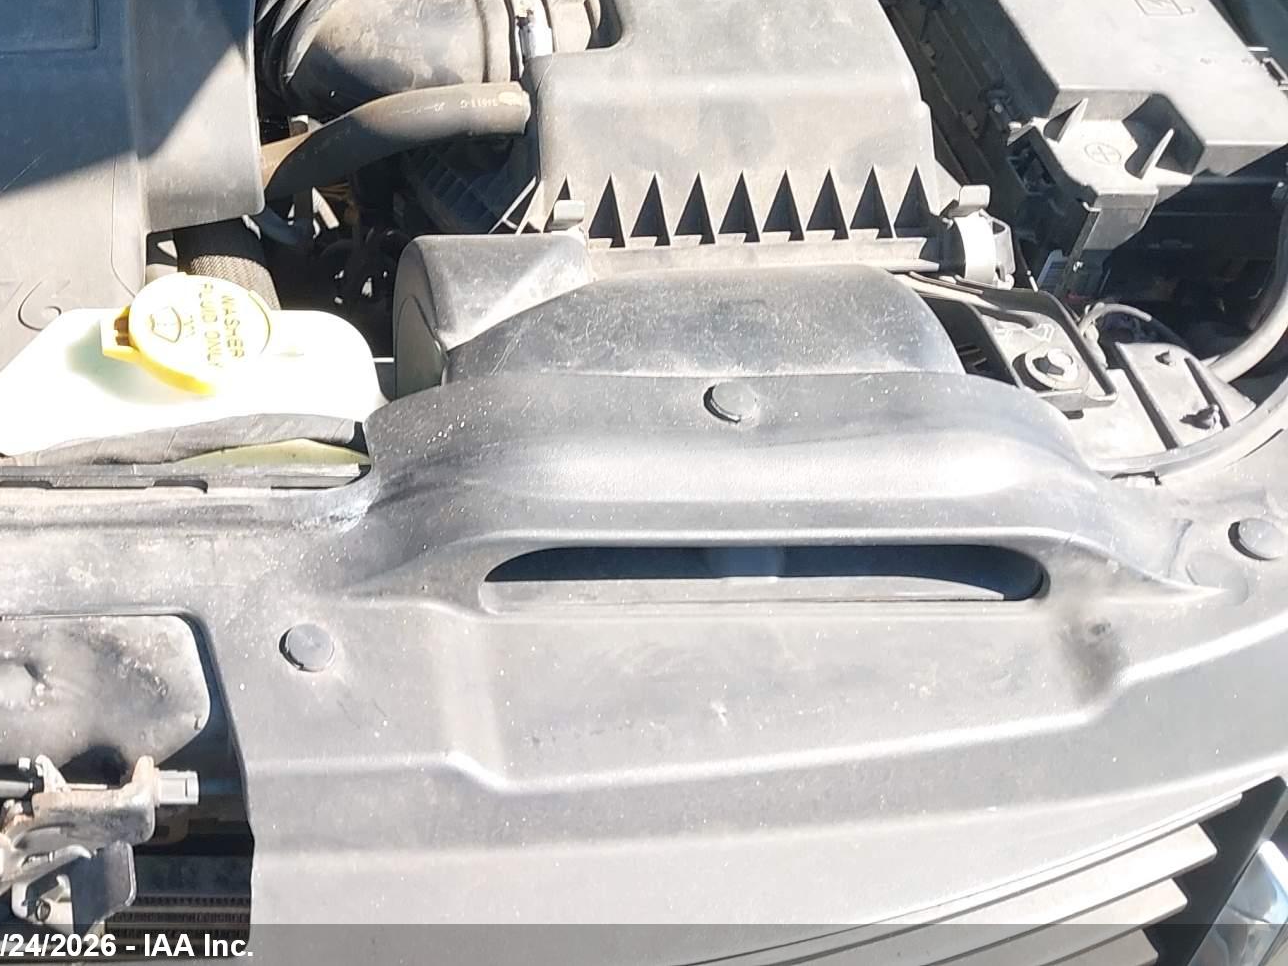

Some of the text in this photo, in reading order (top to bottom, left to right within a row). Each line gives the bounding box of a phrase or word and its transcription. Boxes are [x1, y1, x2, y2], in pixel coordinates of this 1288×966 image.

[198, 283, 223, 367] FLUID ONLY
[221, 295, 245, 358] WASHER
